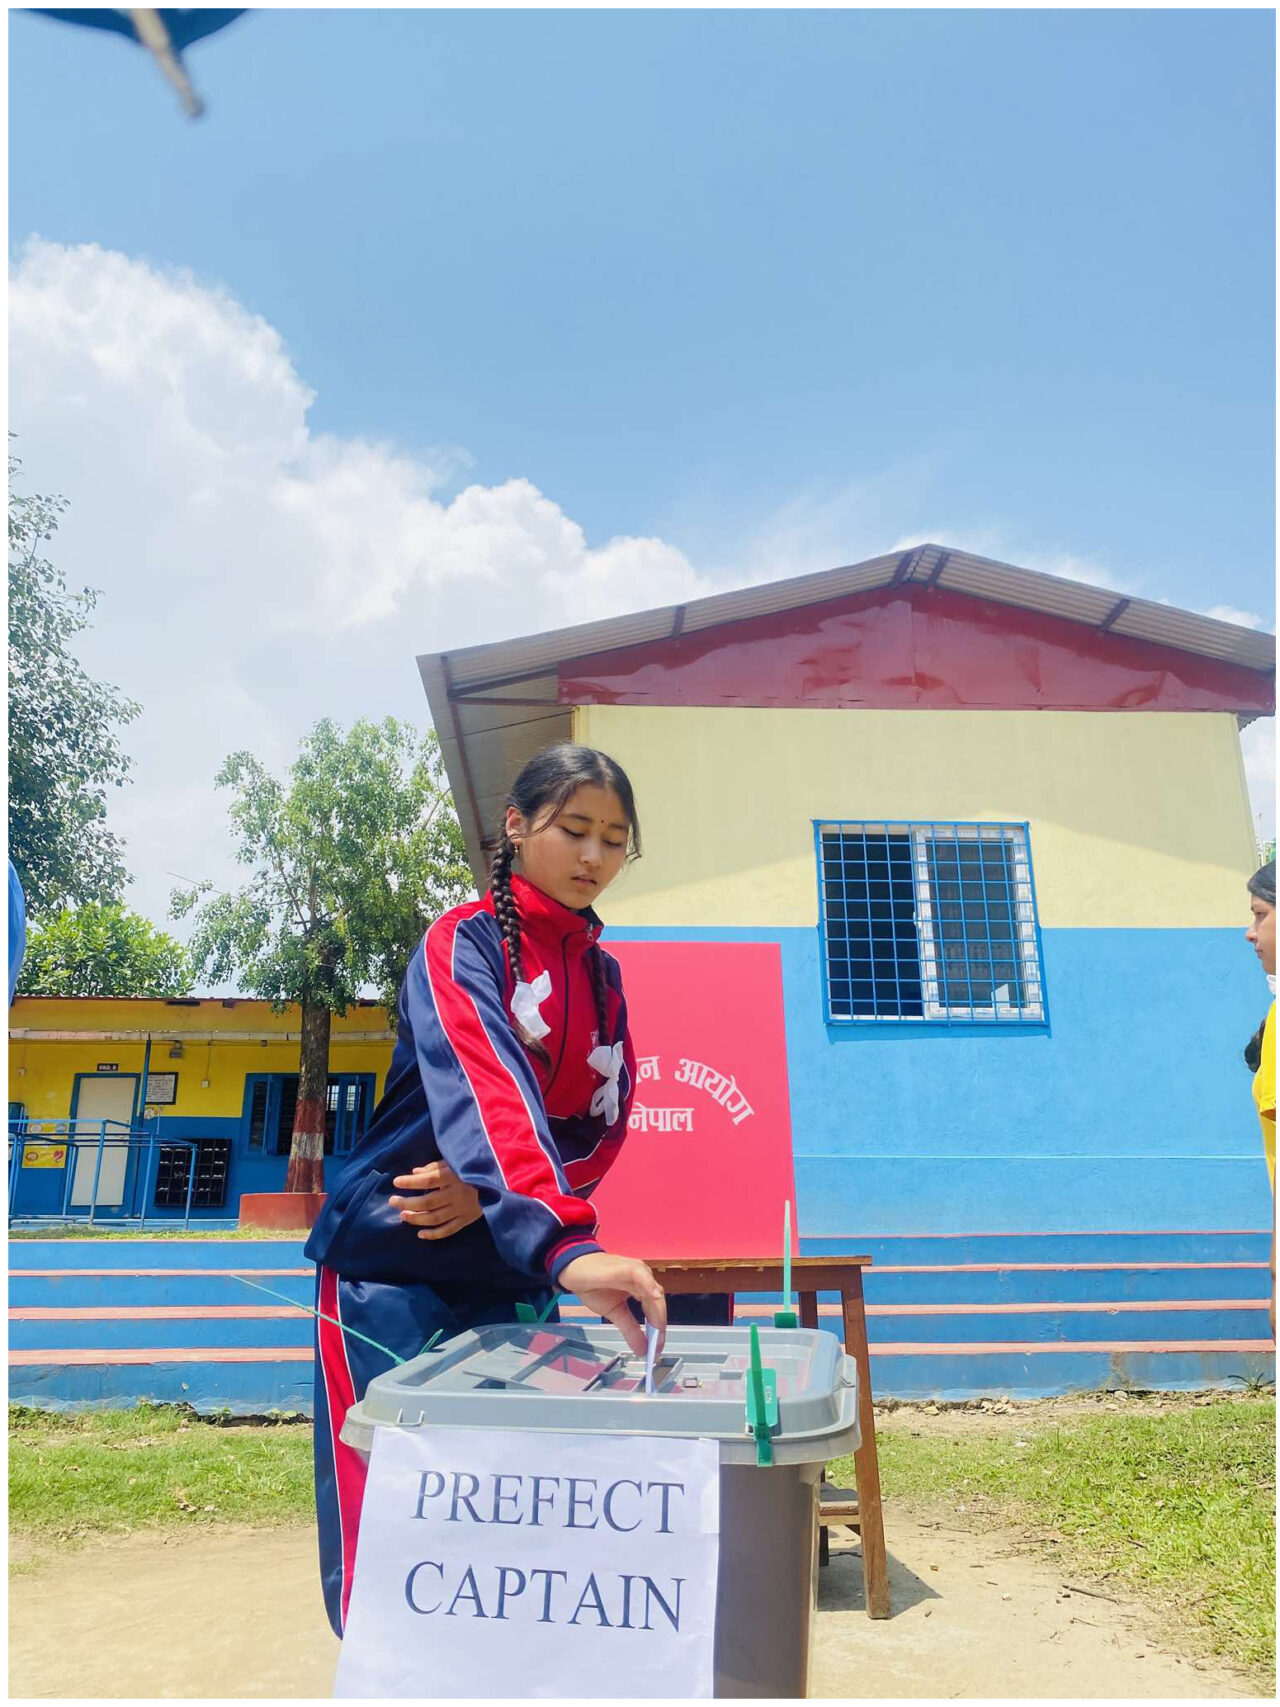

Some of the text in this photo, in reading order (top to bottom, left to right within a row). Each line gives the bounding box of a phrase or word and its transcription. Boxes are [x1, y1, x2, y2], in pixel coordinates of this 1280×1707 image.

[629, 1102, 695, 1132] नेपाल
[673, 1058, 755, 1126] आयोग
[410, 1468, 686, 1535] PREFECT
[404, 1560, 686, 1634] CAPTAIN
